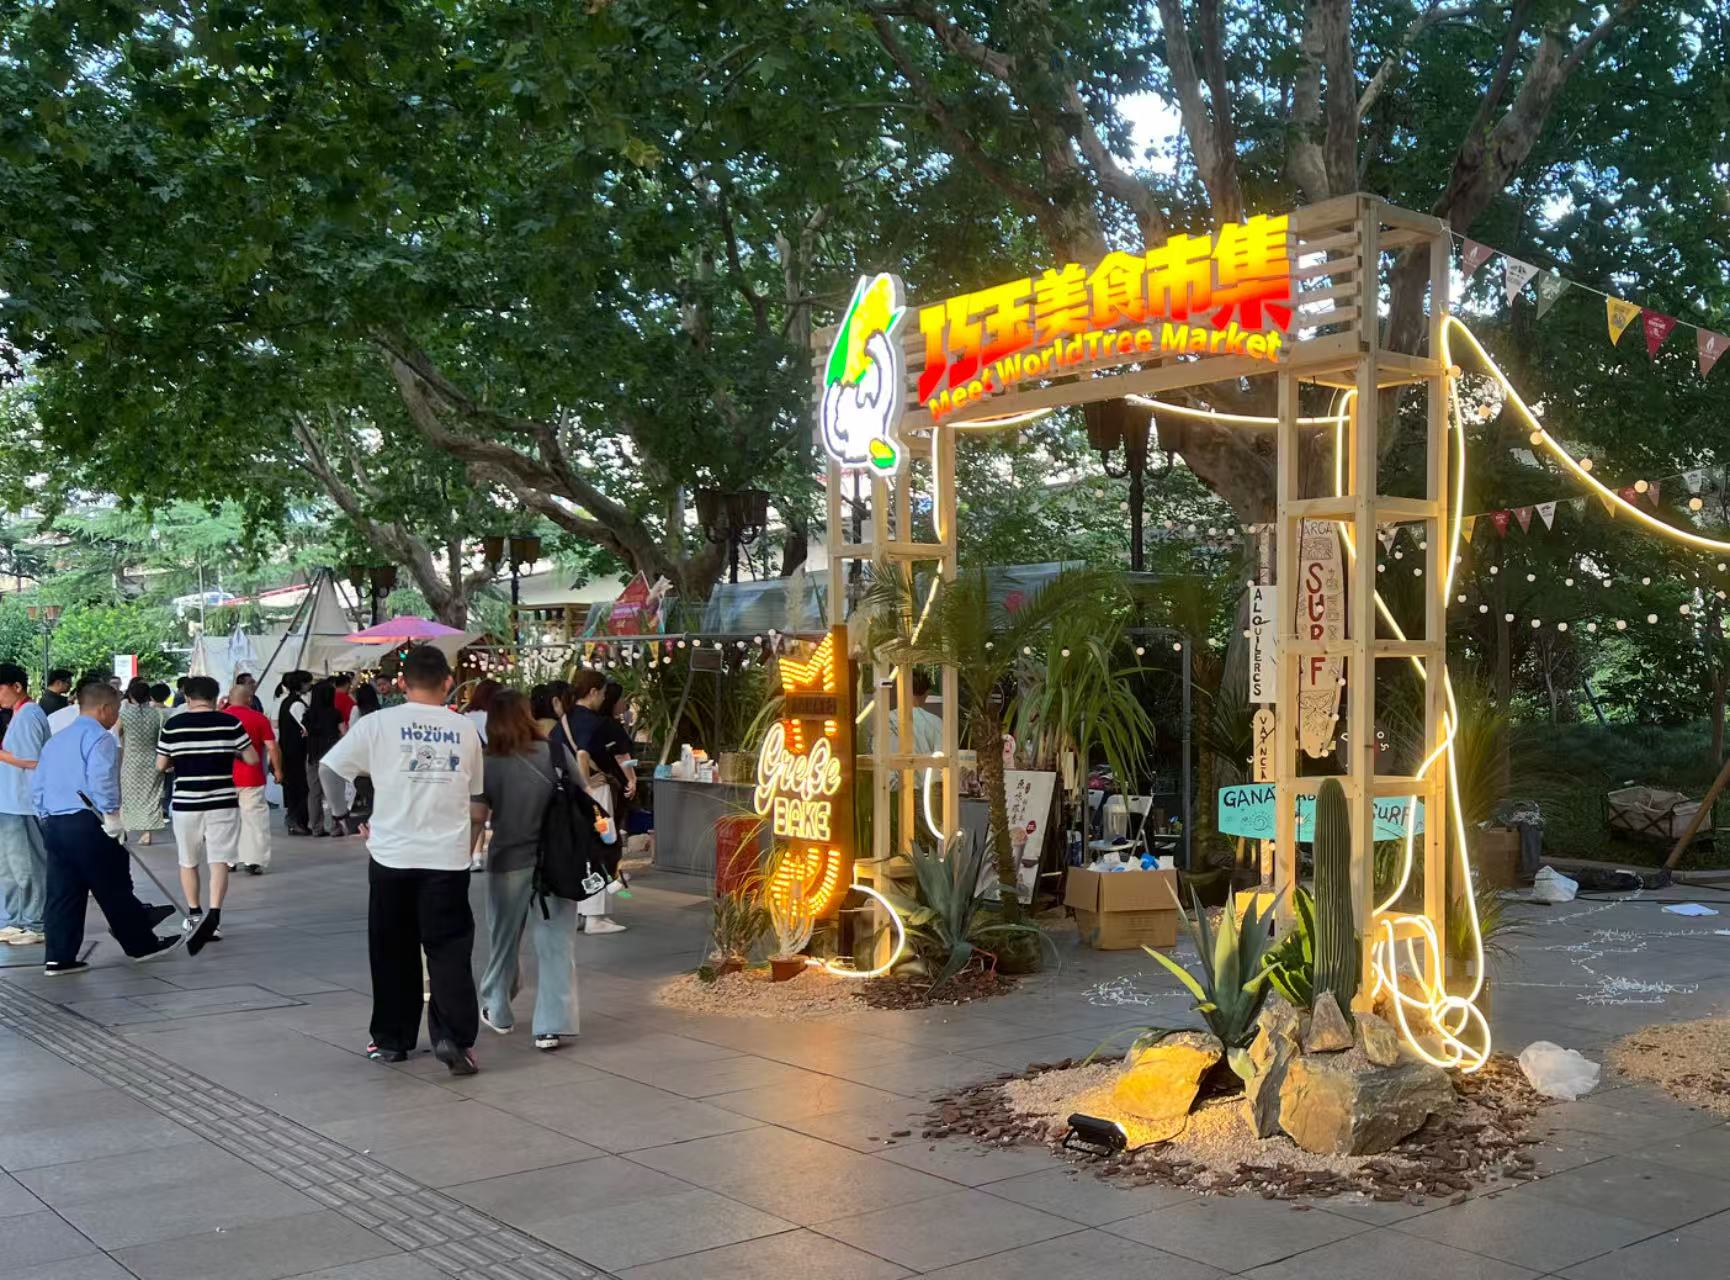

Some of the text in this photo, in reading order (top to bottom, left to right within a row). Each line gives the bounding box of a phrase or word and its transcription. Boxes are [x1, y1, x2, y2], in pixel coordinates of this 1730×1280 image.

[928, 366, 995, 422] Meet
[1160, 321, 1282, 364] Market
[401, 726, 460, 744] HOZUMI
[773, 796, 832, 842] BAKE
